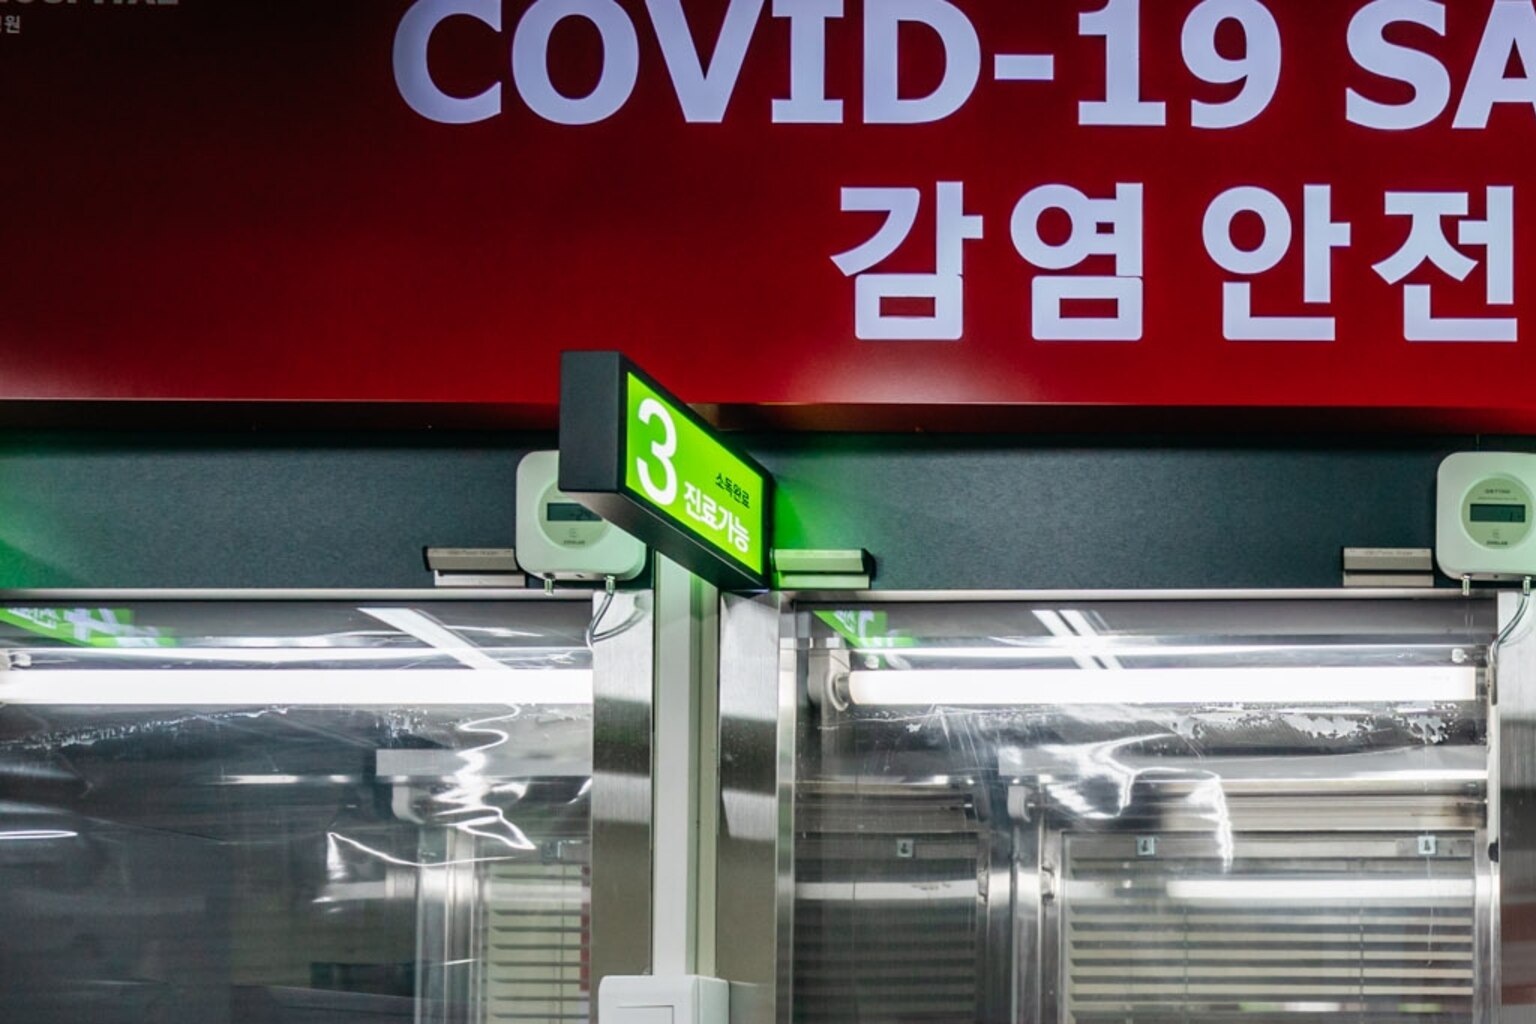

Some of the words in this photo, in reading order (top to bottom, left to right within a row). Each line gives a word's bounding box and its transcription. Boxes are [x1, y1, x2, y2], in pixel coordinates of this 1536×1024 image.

[391, 0, 1282, 129] COVID-19
[636, 397, 678, 506] 3
[715, 472, 751, 510] 소독완료
[684, 481, 750, 553] 진료가능
